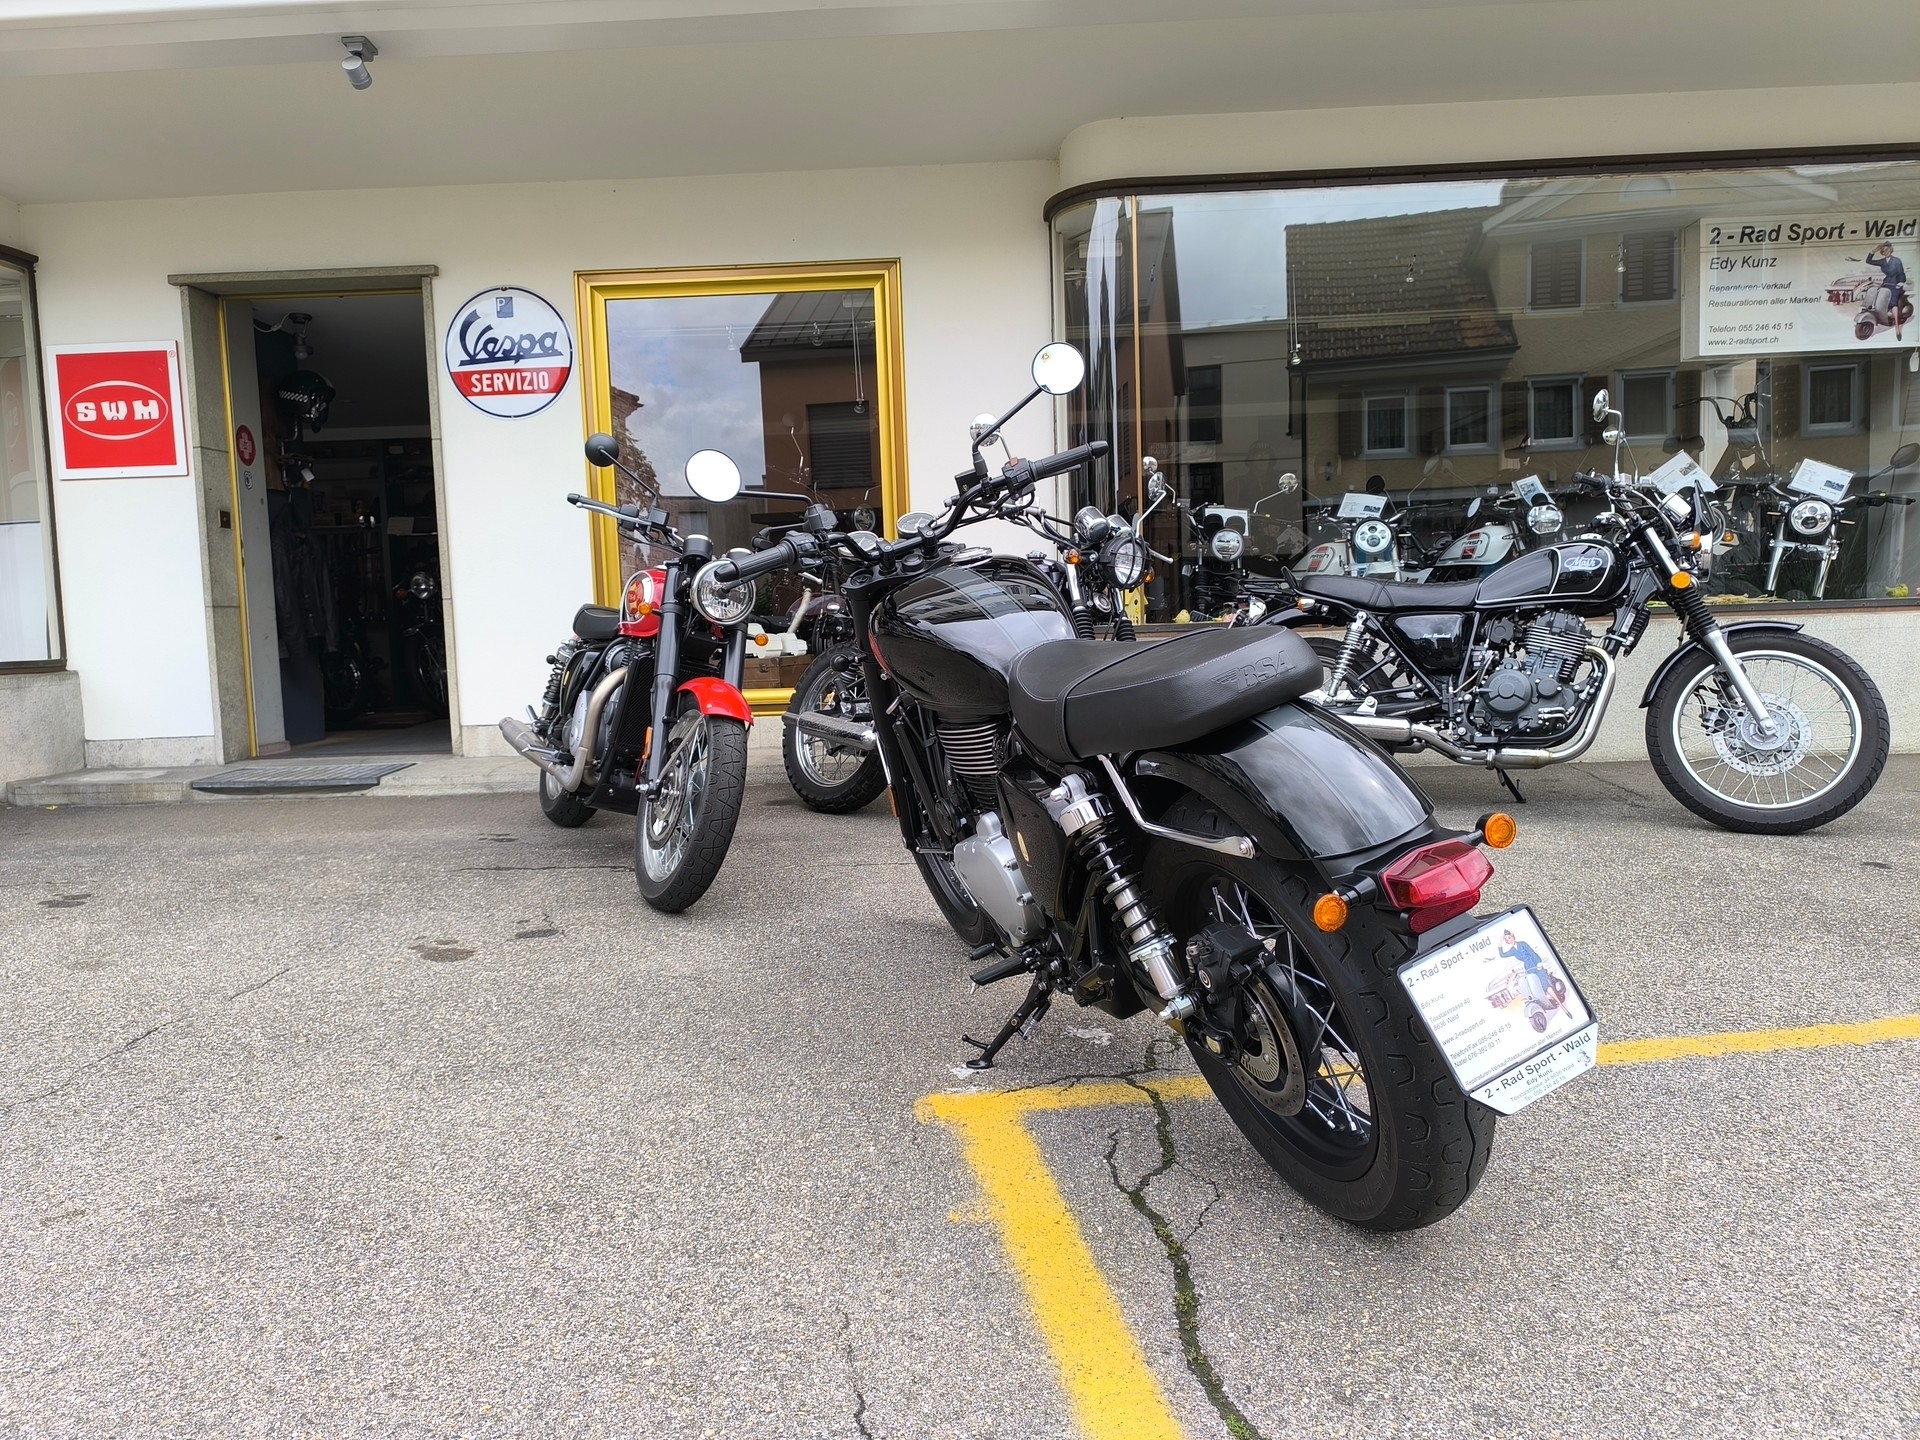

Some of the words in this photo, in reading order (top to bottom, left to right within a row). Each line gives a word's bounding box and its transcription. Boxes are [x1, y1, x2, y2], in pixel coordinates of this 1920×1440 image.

[1709, 226, 1721, 245] 2
[1739, 223, 1782, 244] Rad
[1787, 221, 1846, 246] Sport
[1864, 218, 1917, 238] Wald
[1709, 257, 1737, 273] Edy
[1740, 256, 1778, 269] Kunz
[1708, 281, 1793, 294] Reparaturen-Verkauf
[1708, 299, 1769, 308] Restaurationen
[1770, 298, 1788, 306] aller
[1789, 296, 1822, 304] Marken!
[1709, 325, 1737, 333] Telefon
[1738, 324, 1753, 332] 055
[1755, 323, 1770, 331] 246
[1771, 322, 1782, 330] 45
[1784, 322, 1794, 330] 15
[458, 309, 564, 367] Vespa
[1708, 336, 1779, 346] www.2-radsport.ch
[470, 371, 550, 393] SERVIZIO
[75, 399, 160, 422] SWM
[1406, 977, 1415, 988] 2
[1420, 964, 1440, 981] Rad
[1441, 951, 1464, 971] Sport
[1469, 936, 1492, 955] Wald
[1484, 1088, 1494, 1099] 2
[1500, 1070, 1525, 1090] Rad
[1524, 1052, 1557, 1075] Sport
[1562, 1032, 1591, 1053] Wald
[1526, 1076, 1538, 1086] Edy
[1538, 1067, 1553, 1079] Kunz
